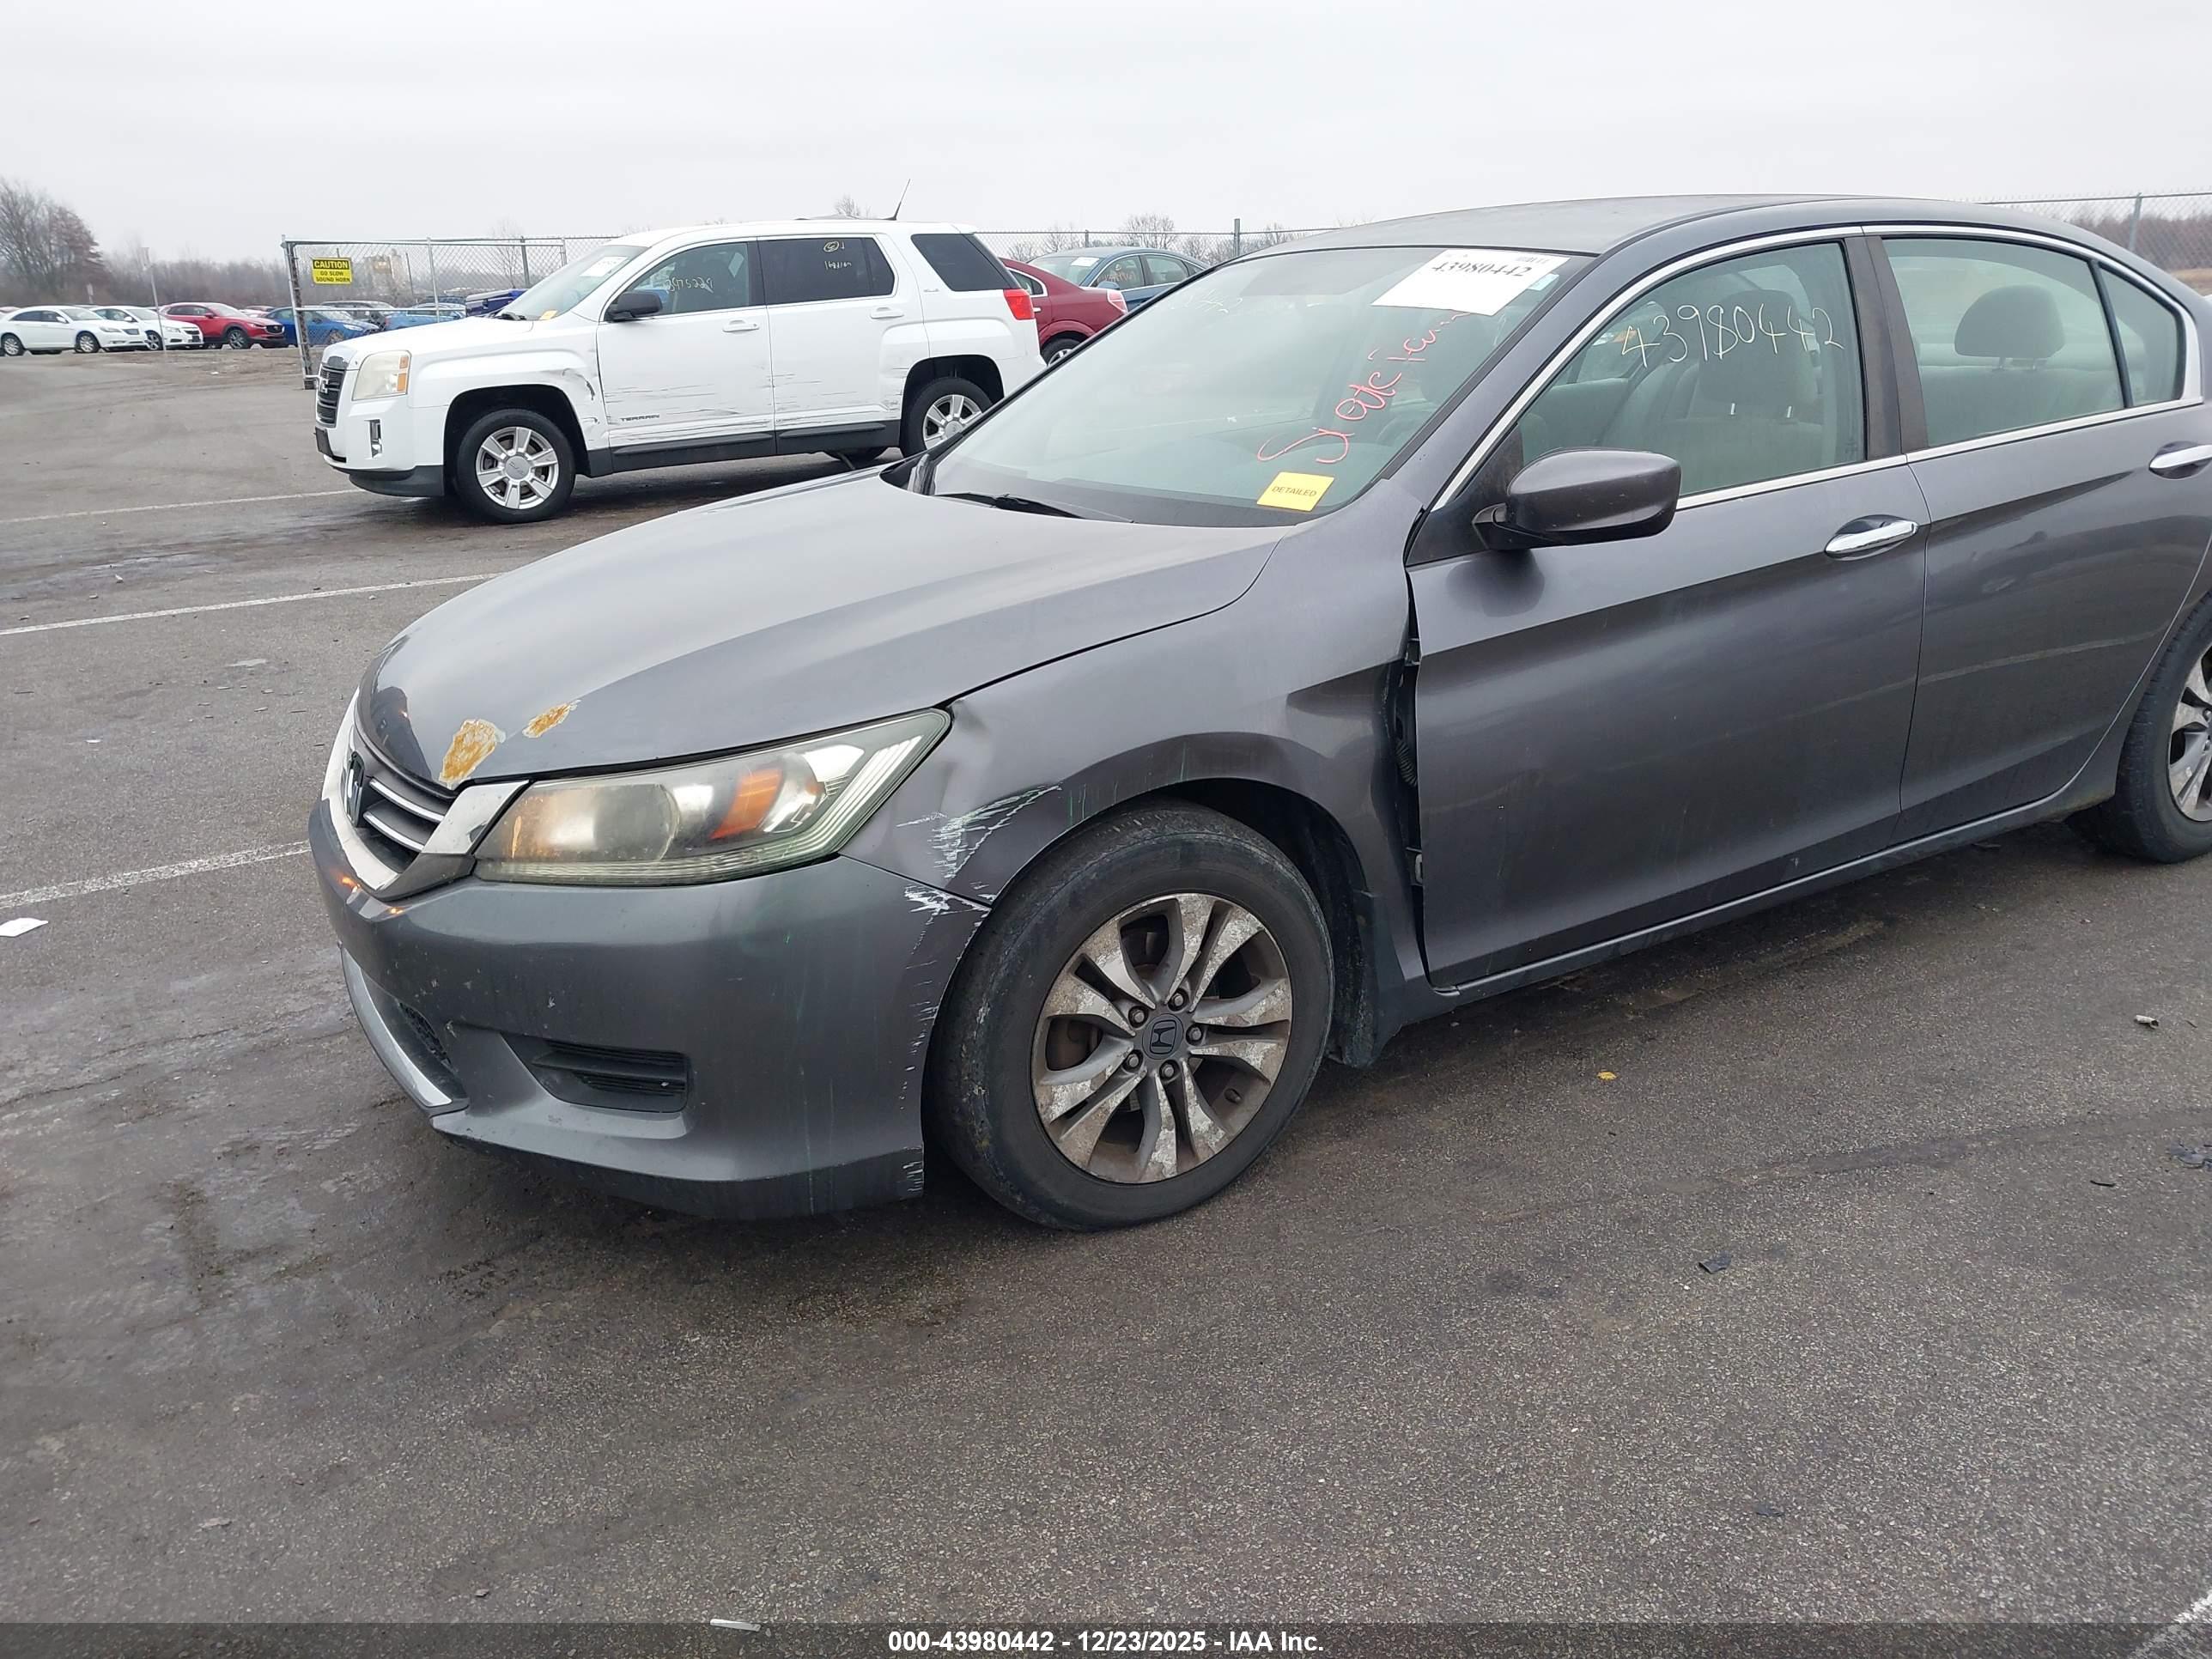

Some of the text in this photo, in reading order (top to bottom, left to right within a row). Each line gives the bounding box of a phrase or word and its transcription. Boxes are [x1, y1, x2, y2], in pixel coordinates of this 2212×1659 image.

[314, 260, 348, 269] CAUTION
[1431, 261, 1532, 276] 43980442
[1621, 303, 1845, 369] 43980442
[1272, 486, 1317, 496] DETAILED
